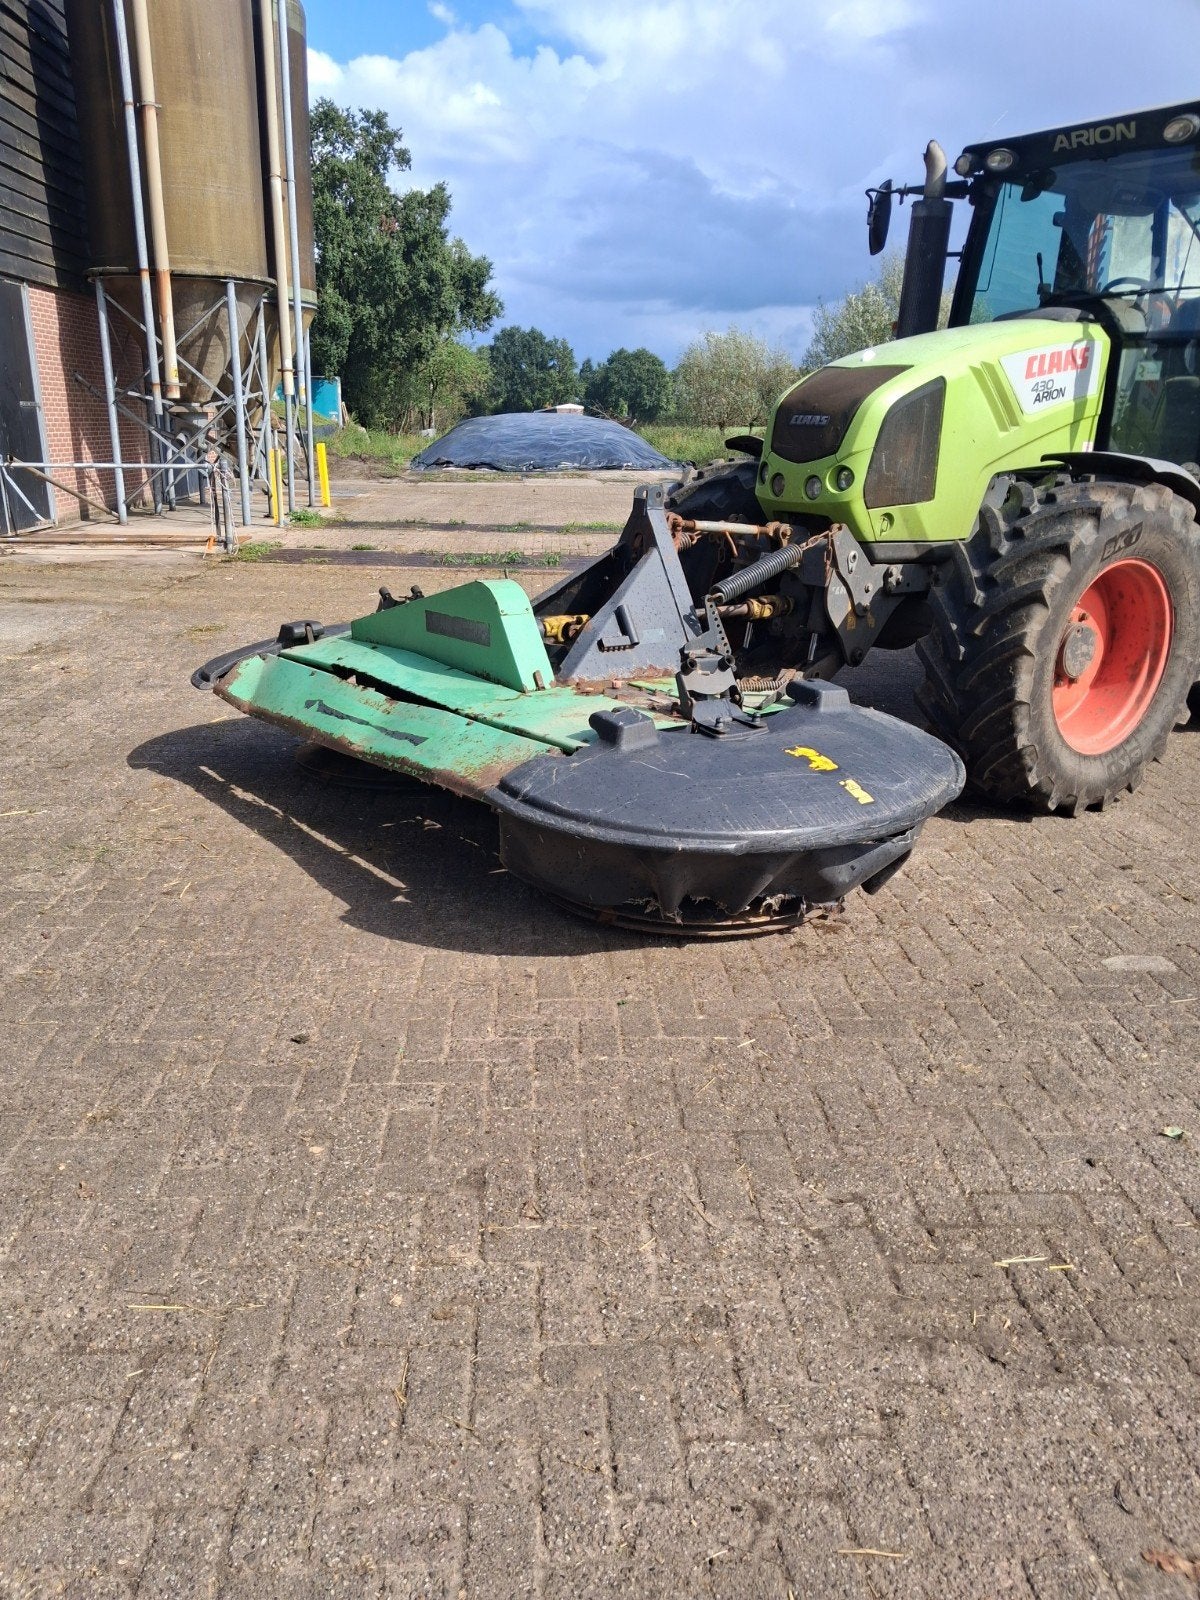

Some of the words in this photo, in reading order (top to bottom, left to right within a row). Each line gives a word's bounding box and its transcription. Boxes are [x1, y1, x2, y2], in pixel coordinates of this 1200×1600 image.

[1052, 121, 1136, 152] ARION
[1025, 346, 1090, 380] CLAAS
[1031, 379, 1054, 393] 430
[1033, 387, 1066, 404] ARION
[791, 415, 829, 425] CLAAS
